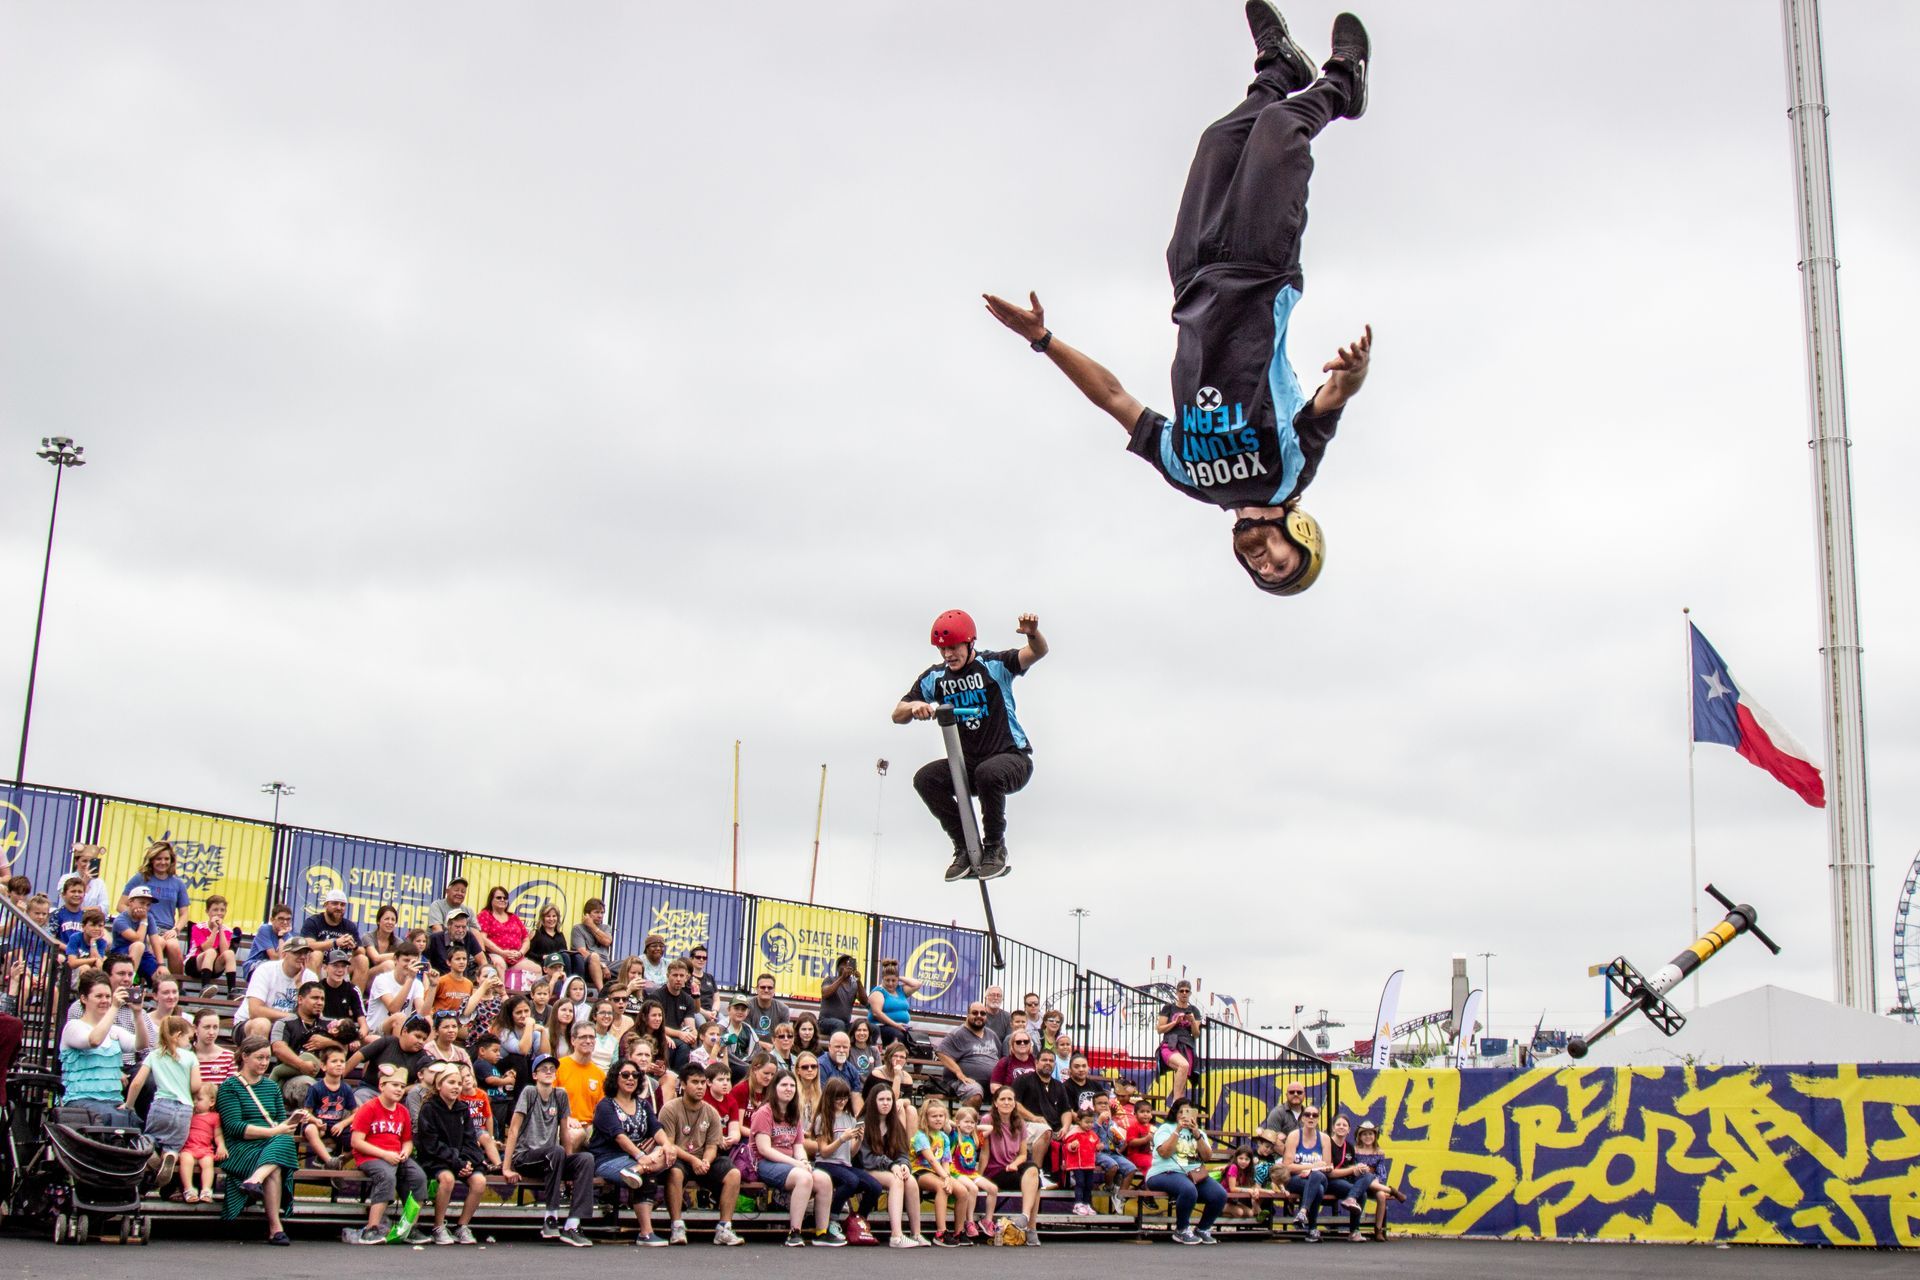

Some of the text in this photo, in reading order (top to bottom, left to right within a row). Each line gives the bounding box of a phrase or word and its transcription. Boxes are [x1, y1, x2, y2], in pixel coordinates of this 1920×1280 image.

[1183, 402, 1248, 434] TEAM
[1182, 427, 1260, 462] STUNT
[940, 672, 984, 696] XPOGO
[943, 688, 987, 708] STUNT
[349, 867, 433, 895] STATE FAIR
[382, 890, 398, 900] OF
[348, 896, 430, 932] TEAS
[651, 899, 710, 926] XTREME
[648, 924, 710, 940] SPORTS
[798, 928, 859, 951] STATE FAIR
[823, 948, 834, 957] OF
[798, 954, 839, 978] TEX
[917, 971, 940, 981] HOUR
[919, 950, 954, 981] 24
